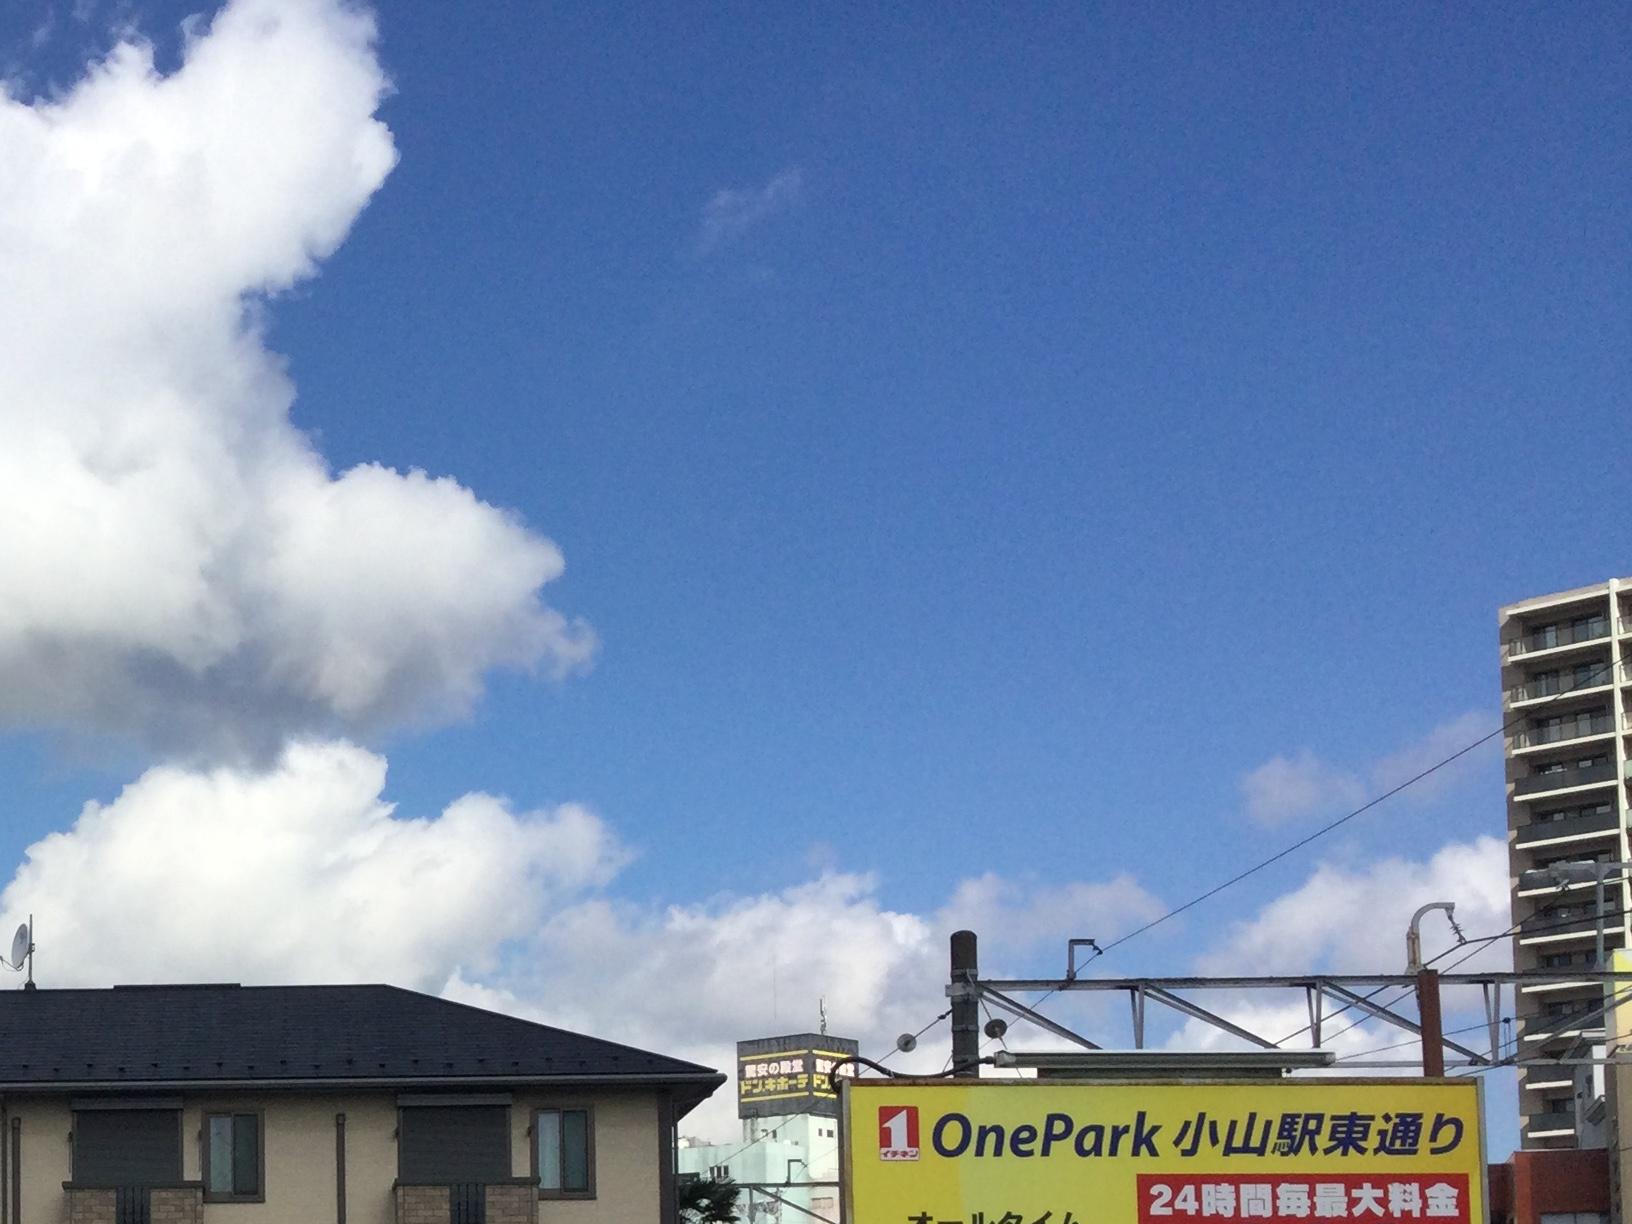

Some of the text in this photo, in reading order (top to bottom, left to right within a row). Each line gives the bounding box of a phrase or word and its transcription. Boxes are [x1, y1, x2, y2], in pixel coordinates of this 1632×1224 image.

[932, 1111, 1464, 1158] OnePark 小山駅東通り
[1149, 1182, 1460, 1218] 24時間毎最大料金
